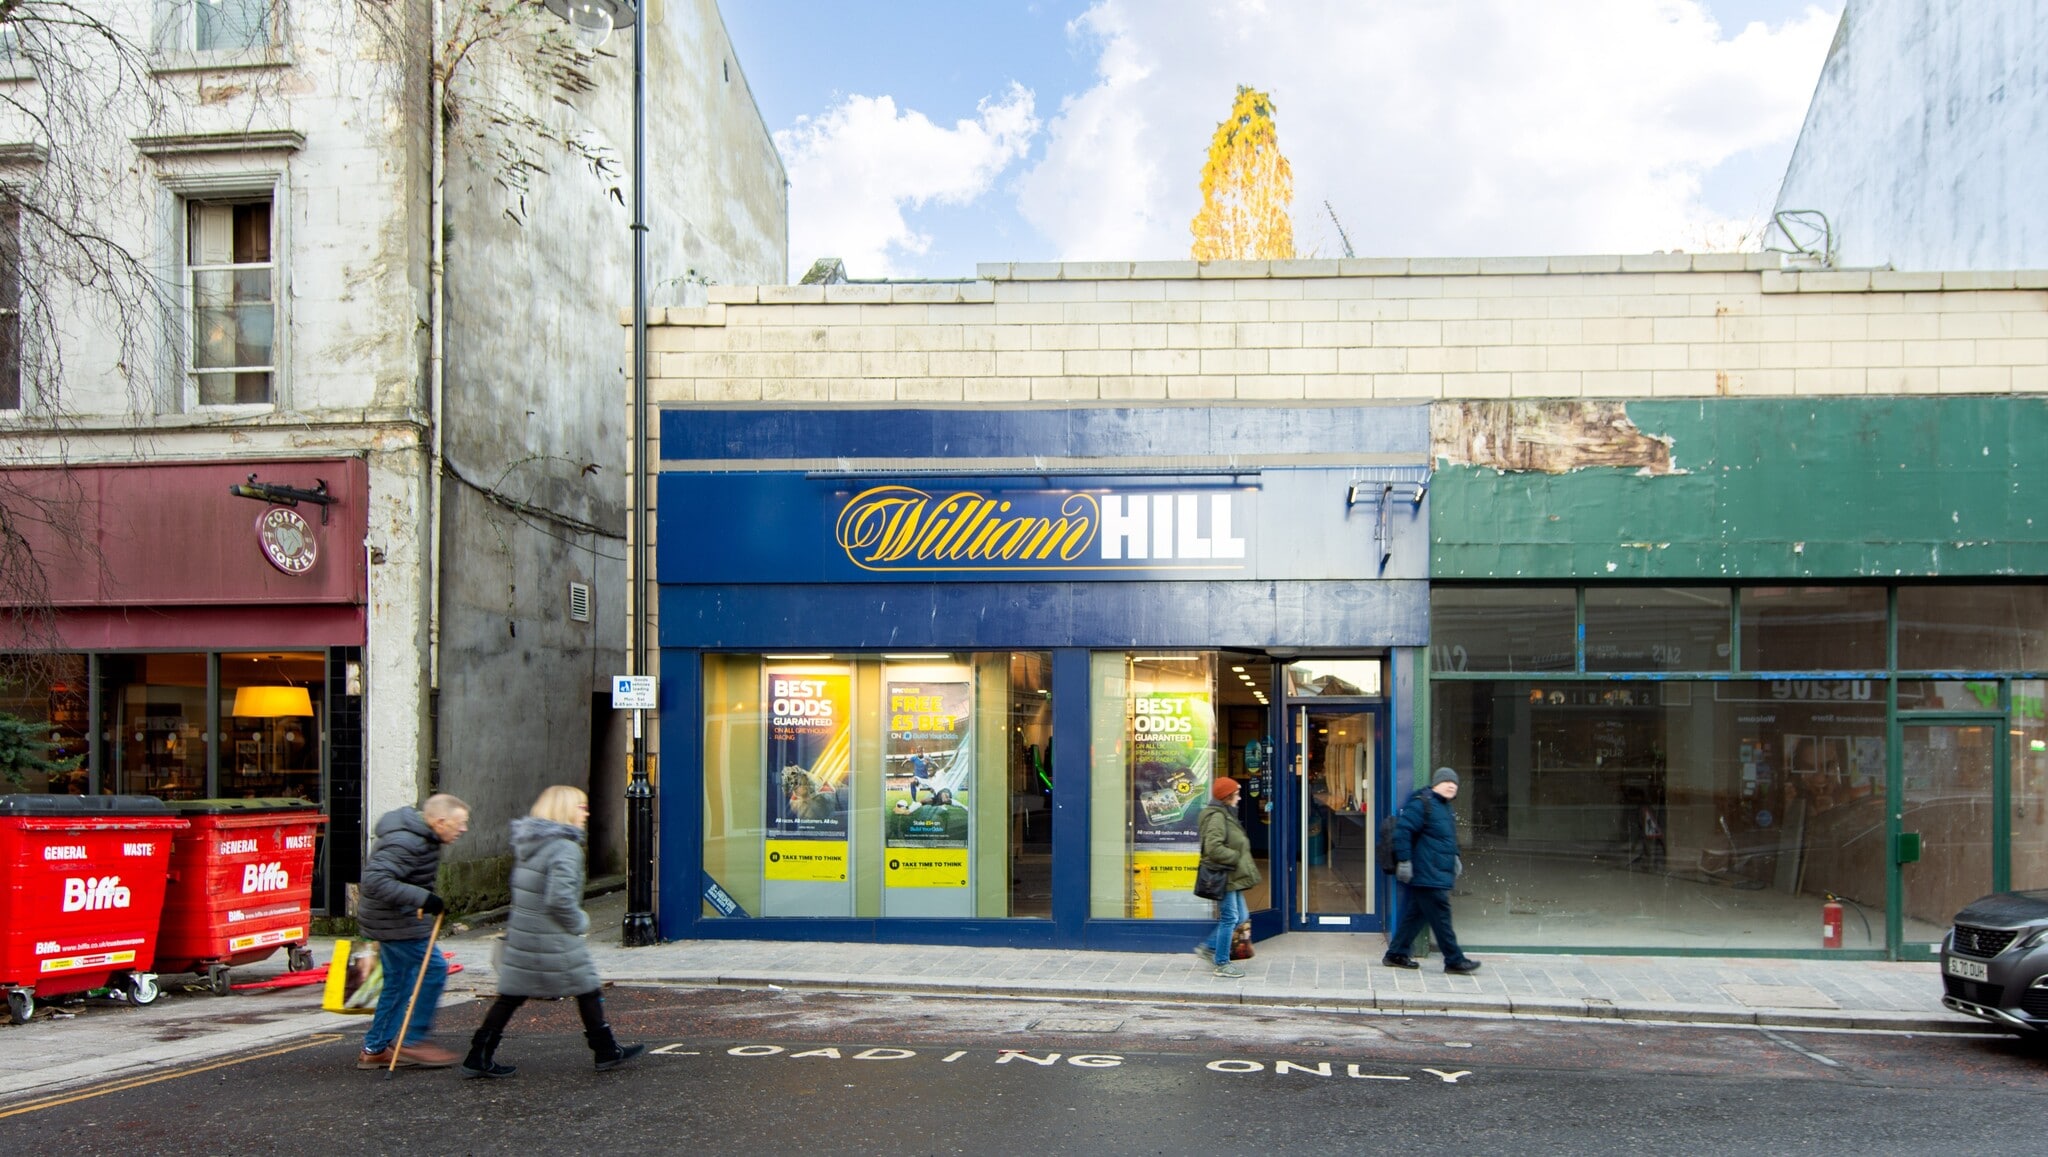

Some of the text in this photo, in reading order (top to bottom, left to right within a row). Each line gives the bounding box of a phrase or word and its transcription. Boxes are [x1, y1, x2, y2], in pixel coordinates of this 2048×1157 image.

[267, 511, 305, 532] COSTA
[836, 485, 1245, 566] William HILL
[269, 544, 314, 570] COFFEE
[774, 680, 827, 698] BEST
[773, 698, 833, 717] ODDS
[891, 695, 944, 712] FREE
[1135, 698, 1185, 715] BEST
[773, 717, 833, 726] GUARANTEED
[891, 714, 957, 731] £5 BET
[1135, 716, 1192, 733] ODDS
[1135, 733, 1192, 742] GUARANTEED
[44, 843, 153, 861] GENERAL WASTE
[220, 835, 313, 855] GENERAL WASTE
[242, 861, 289, 894] Biffa
[63, 875, 131, 912] Biffa
[228, 910, 245, 922] Biffa
[36, 941, 61, 955] Biffa
[649, 1043, 1473, 1083] LOADING ONLY
